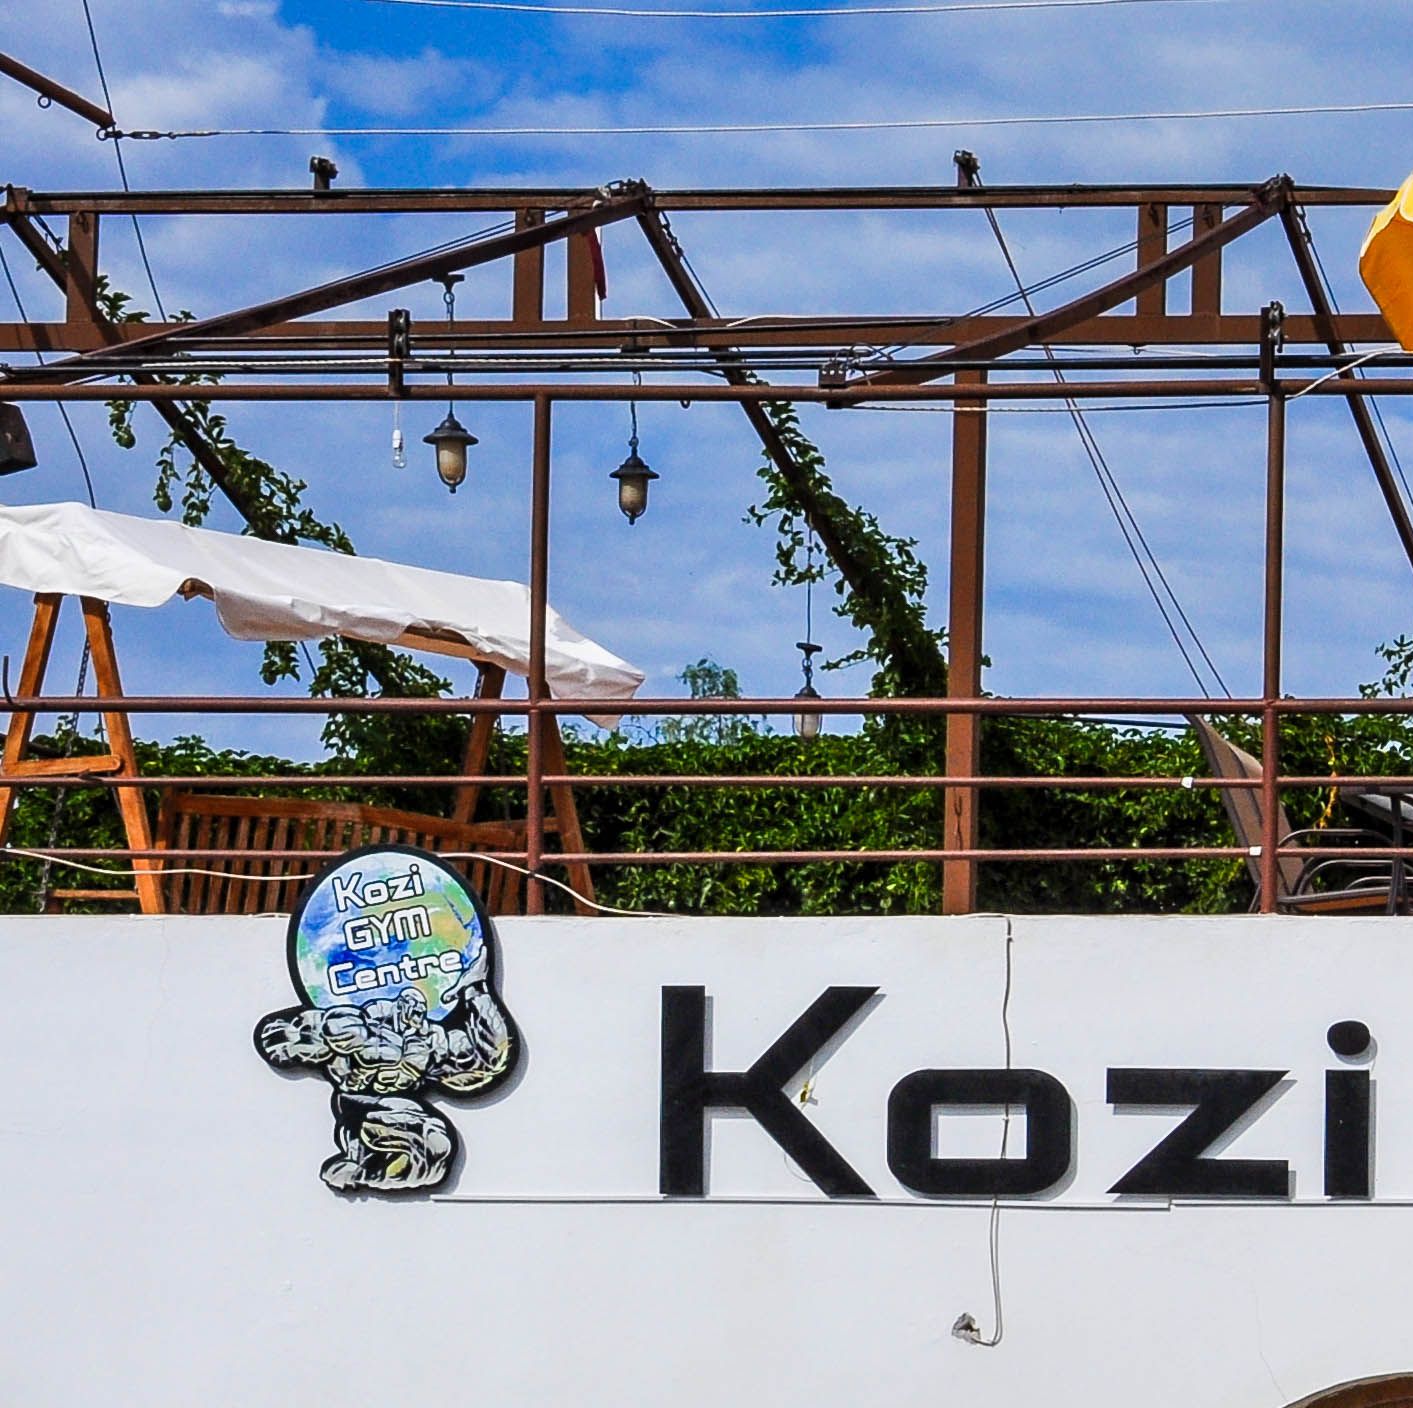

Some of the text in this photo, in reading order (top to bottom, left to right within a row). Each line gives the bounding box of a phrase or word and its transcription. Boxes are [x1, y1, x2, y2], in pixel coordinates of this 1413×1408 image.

[332, 863, 424, 912] Kozi
[343, 905, 431, 952] GYM
[328, 949, 464, 997] Centre
[660, 986, 1372, 1198] Kozi
